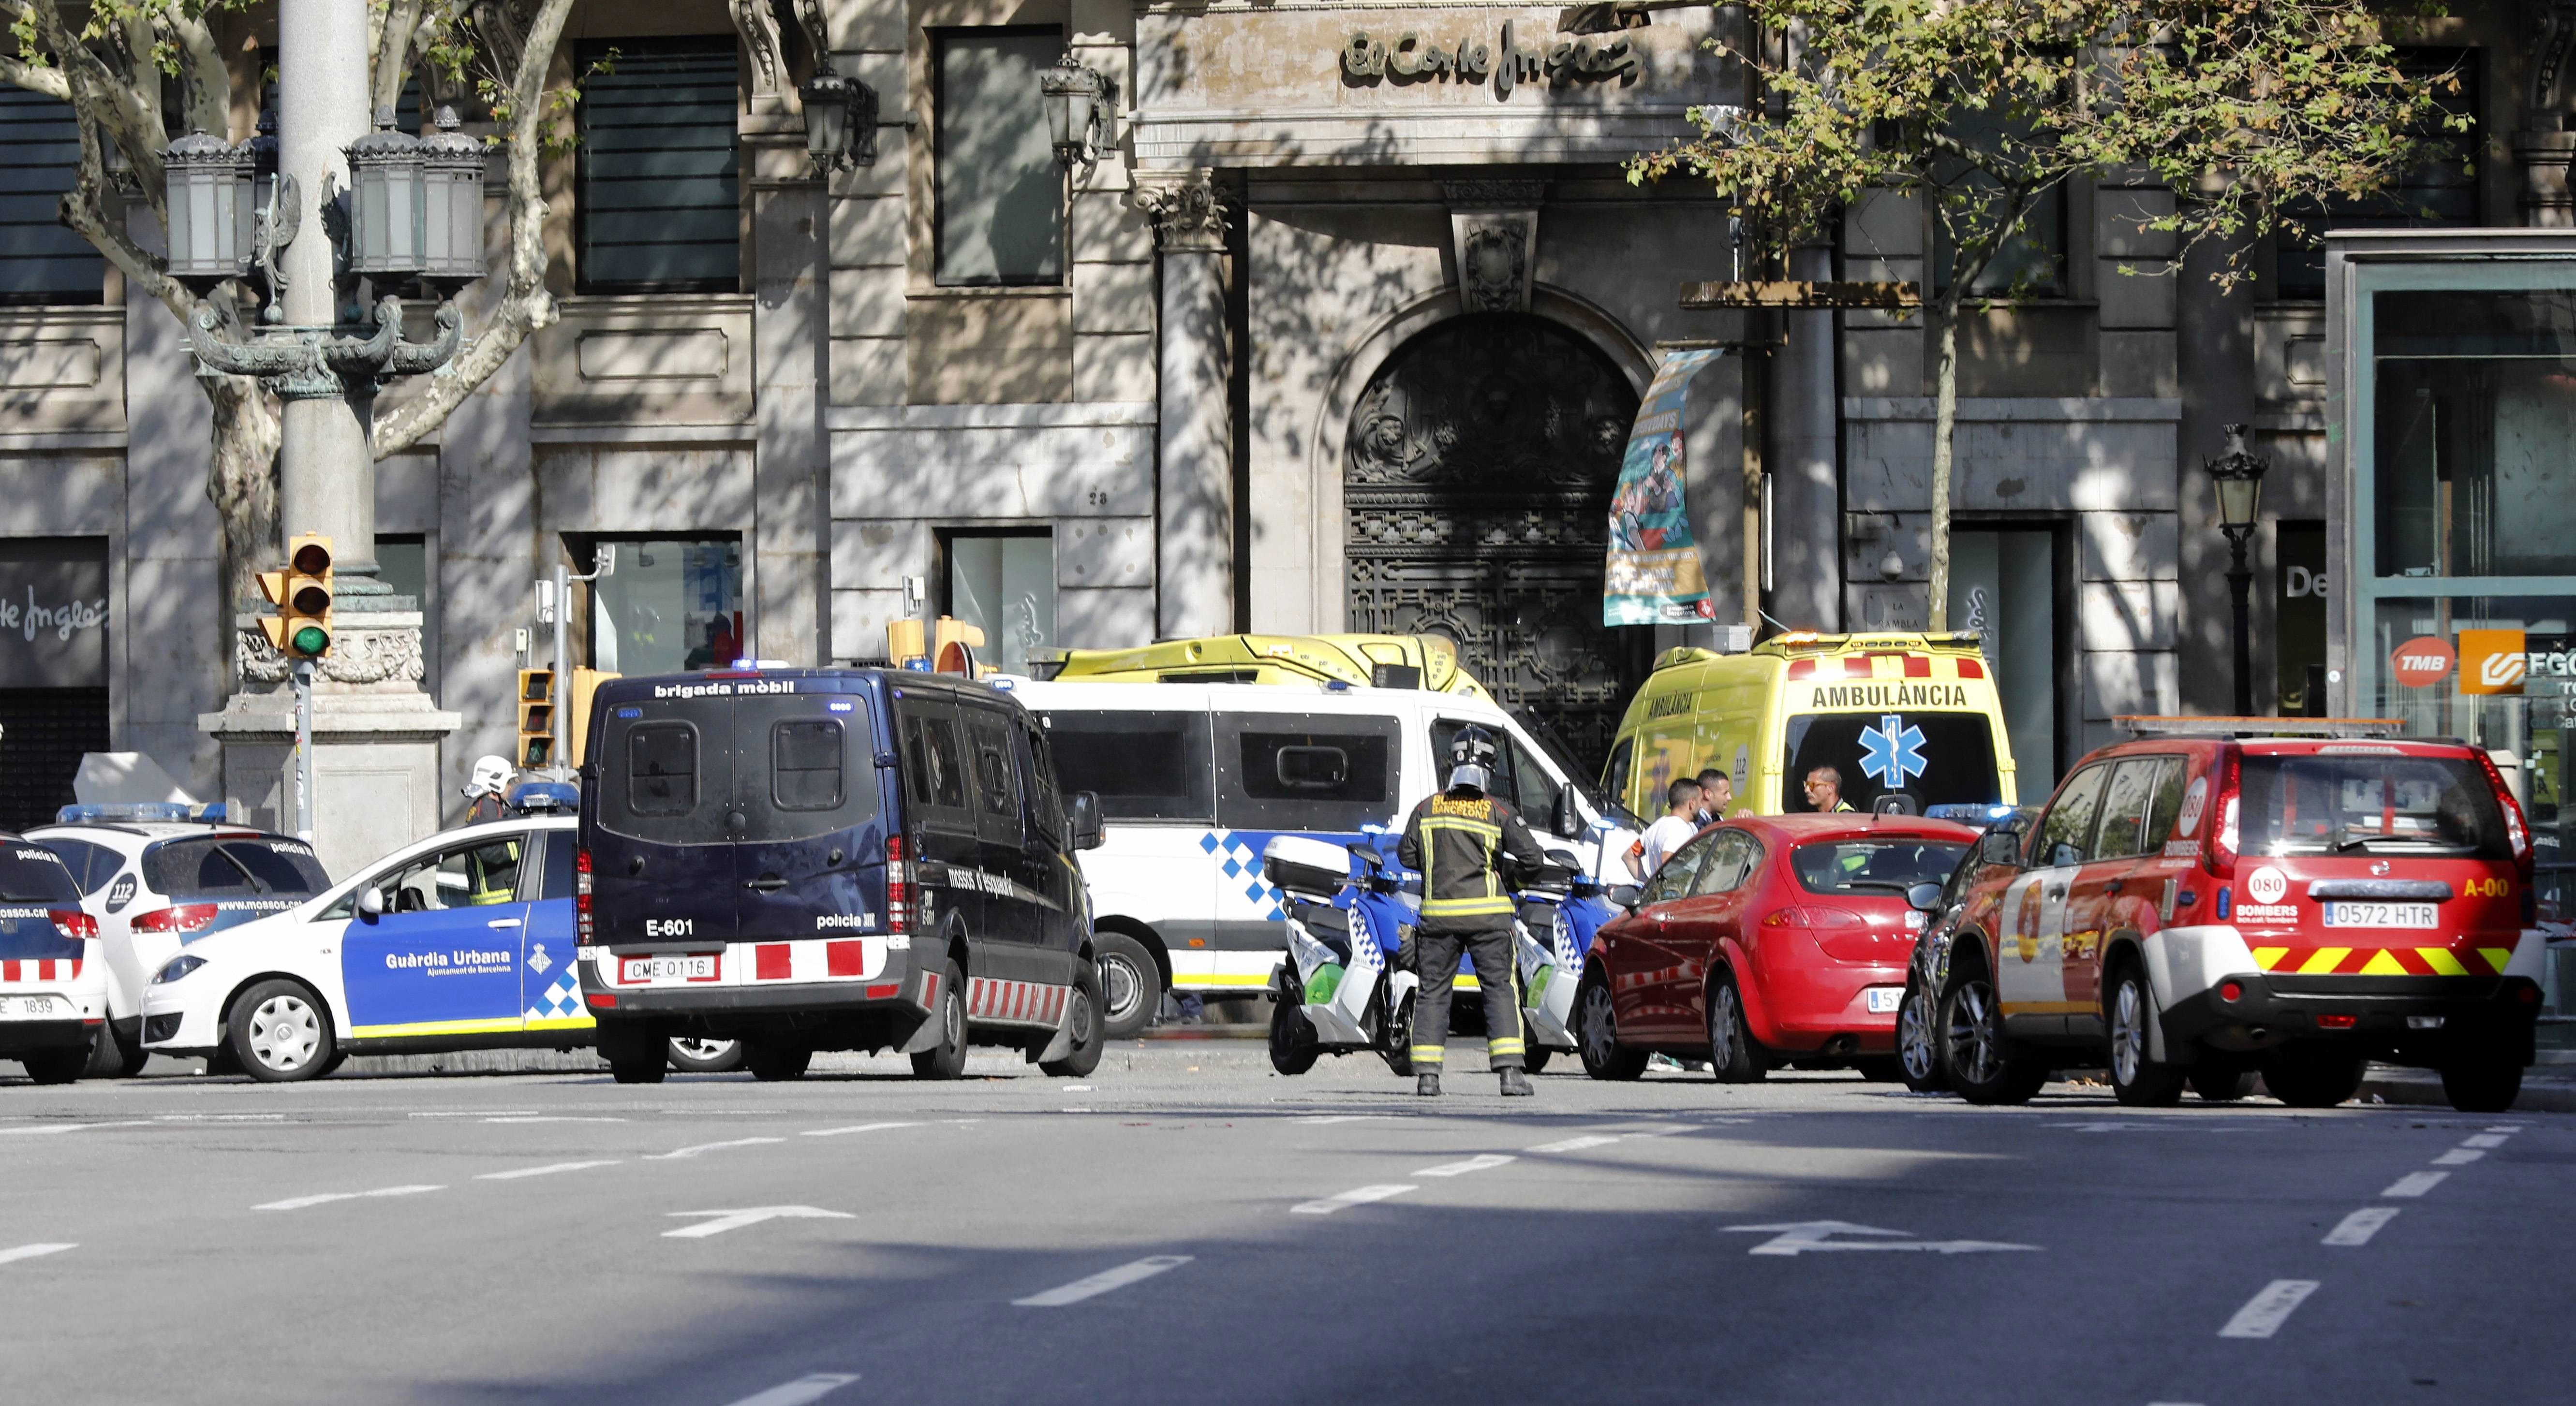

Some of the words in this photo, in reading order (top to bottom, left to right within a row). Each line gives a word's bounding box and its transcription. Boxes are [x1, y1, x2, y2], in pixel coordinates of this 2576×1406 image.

[1345, 30, 1386, 76] El
[1390, 31, 1489, 76] Corte
[2287, 565, 2327, 598] De
[2402, 655, 2445, 671] TMB
[654, 682, 731, 699] brigada
[737, 679, 795, 694] mòbil
[1812, 680, 1967, 707] AMBULÀNCIA
[1734, 757, 1747, 775] 112
[1432, 804, 1488, 821] BARCELONA
[2182, 795, 2203, 818] 080
[15, 849, 51, 863] policia
[270, 843, 306, 855] policia
[2164, 840, 2200, 857] BOMBERS
[112, 882, 134, 899] 112
[947, 868, 976, 891] mossos
[976, 864, 1014, 900] d'esquadra
[2253, 878, 2282, 892] 080
[2464, 878, 2509, 897] A-00
[2236, 904, 2298, 917] BOMBERS
[2338, 905, 2388, 924] 0572
[2396, 906, 2433, 925] HTR
[646, 919, 693, 937] E-601
[816, 912, 861, 930] policia
[385, 952, 448, 969] Guàrdia
[453, 949, 511, 966] Urbana
[427, 967, 467, 978] Ajuntament
[468, 966, 477, 974] de
[477, 964, 511, 974] Barcelona
[633, 961, 661, 978] CME
[667, 960, 706, 976] 0116
[24, 999, 53, 1014] 1839
